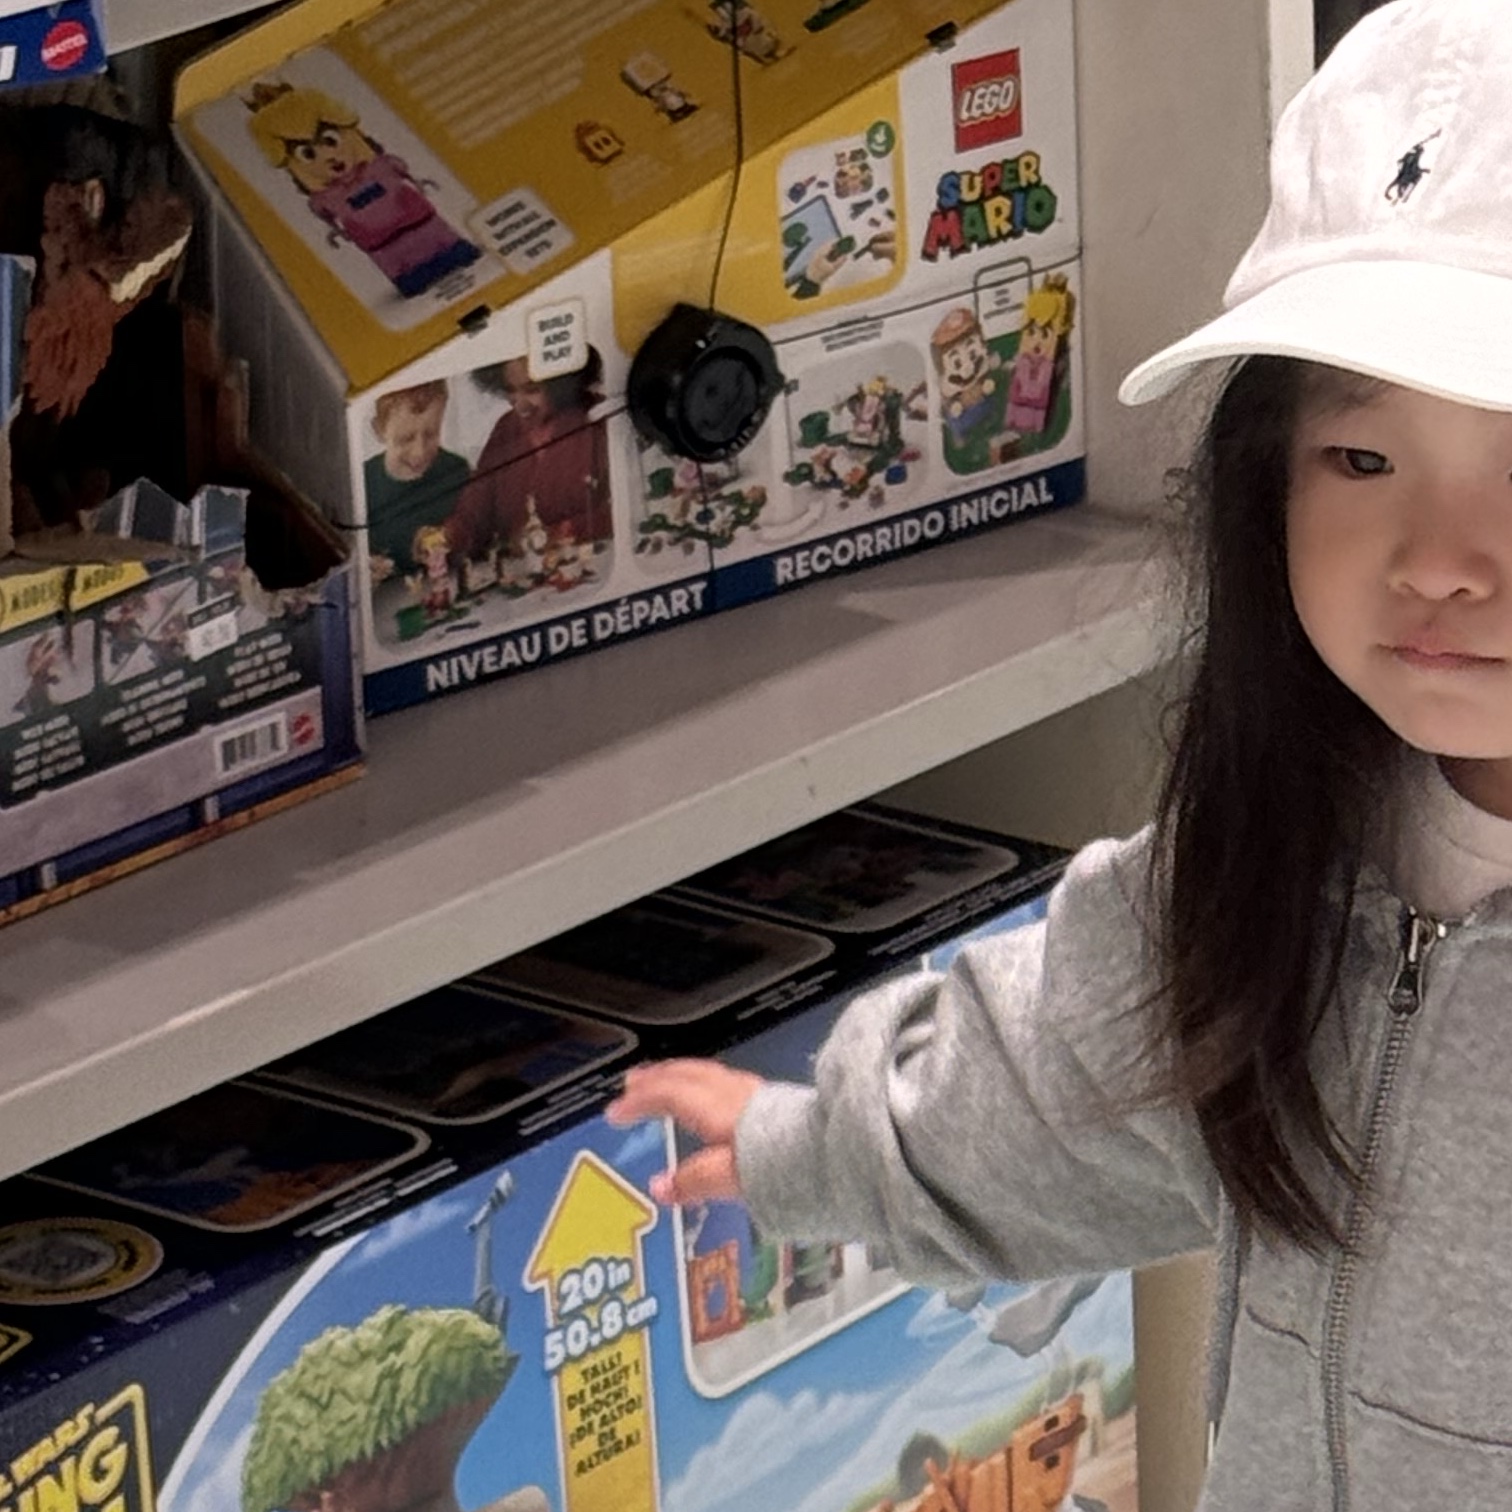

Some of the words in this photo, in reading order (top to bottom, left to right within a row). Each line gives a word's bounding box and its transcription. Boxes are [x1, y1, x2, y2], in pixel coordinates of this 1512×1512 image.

[960, 79, 1015, 121] LEGO
[937, 150, 1041, 209] SUPER
[921, 185, 1057, 262] MARIO
[537, 313, 574, 333] BUILD
[543, 330, 571, 347] AND
[543, 345, 572, 363] PLAY
[775, 510, 945, 585] RECORRIDO
[950, 476, 1054, 531] INICIAL
[426, 631, 541, 692] NIVEAU
[549, 619, 588, 655] DE
[594, 581, 708, 641] DÉPART
[558, 1262, 604, 1314] 20
[607, 1259, 632, 1288] in
[545, 1301, 624, 1371] 50.8
[626, 1297, 659, 1326] cm
[567, 1389, 585, 1411] DE
[599, 1427, 616, 1447] DE
